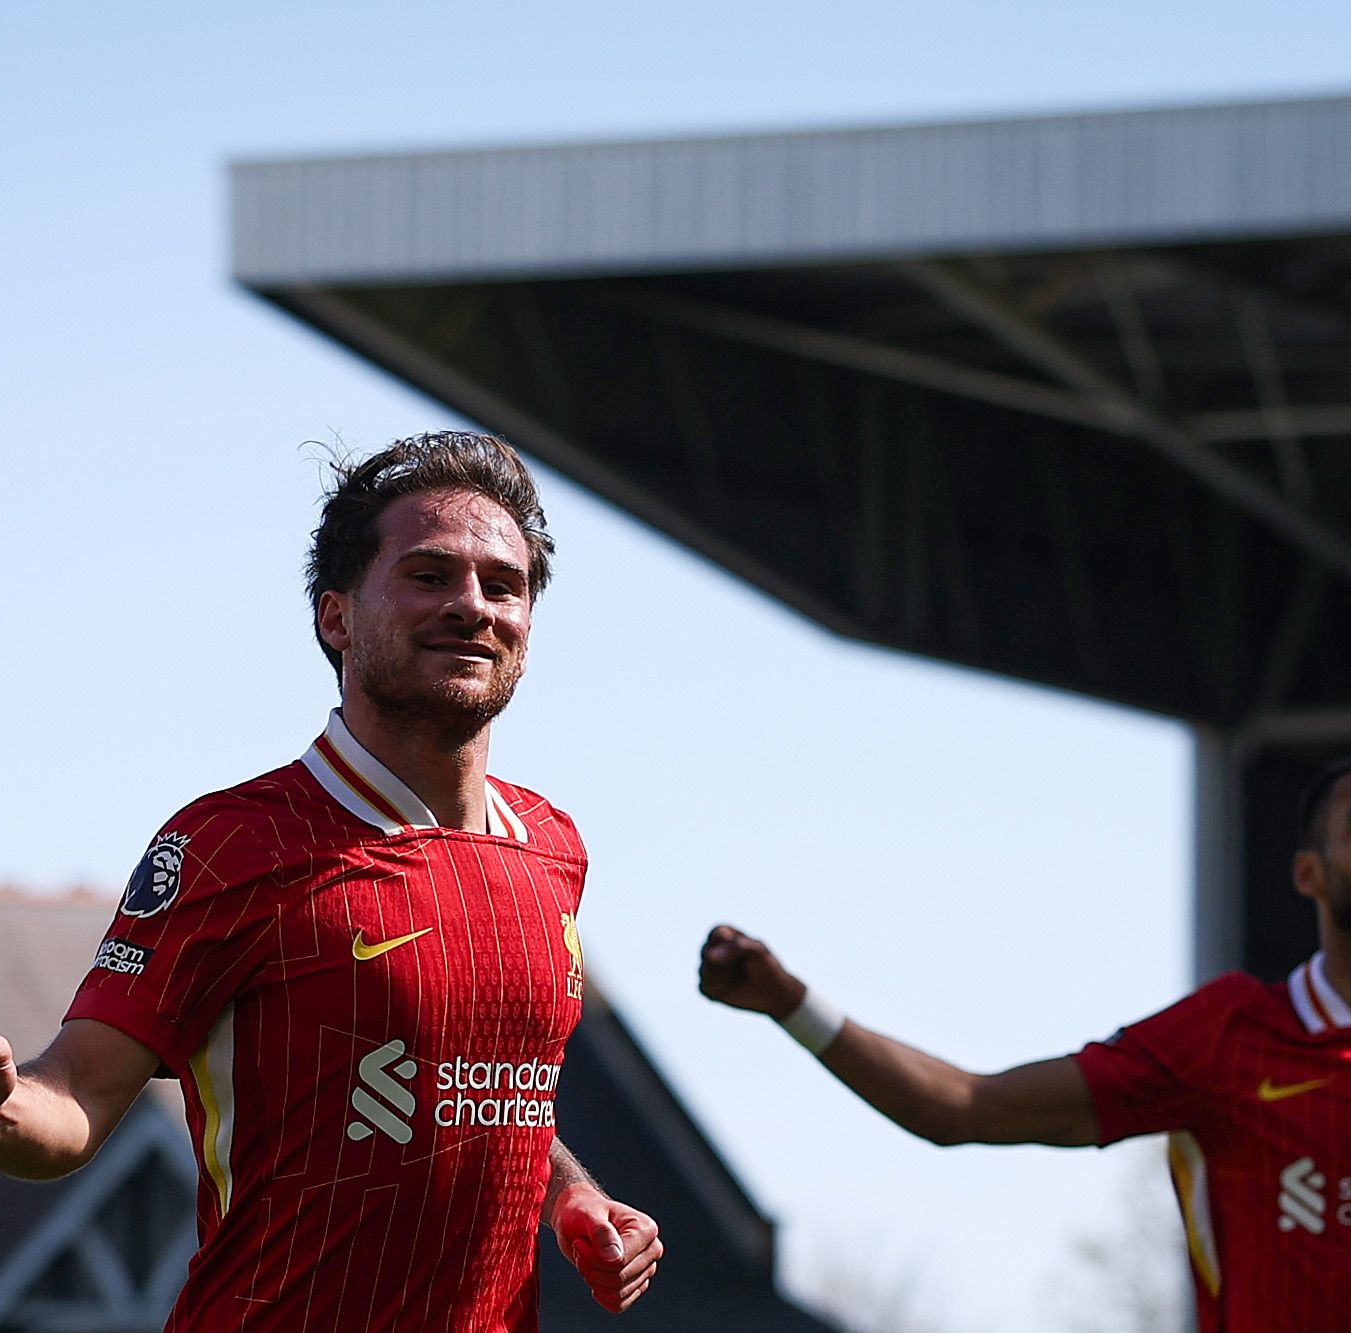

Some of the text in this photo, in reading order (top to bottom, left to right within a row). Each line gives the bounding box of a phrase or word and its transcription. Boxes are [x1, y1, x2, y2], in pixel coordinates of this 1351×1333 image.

[94, 955, 145, 975] acism
[101, 941, 145, 962] oom
[436, 1055, 561, 1091] standar
[434, 1092, 555, 1127] chartere
